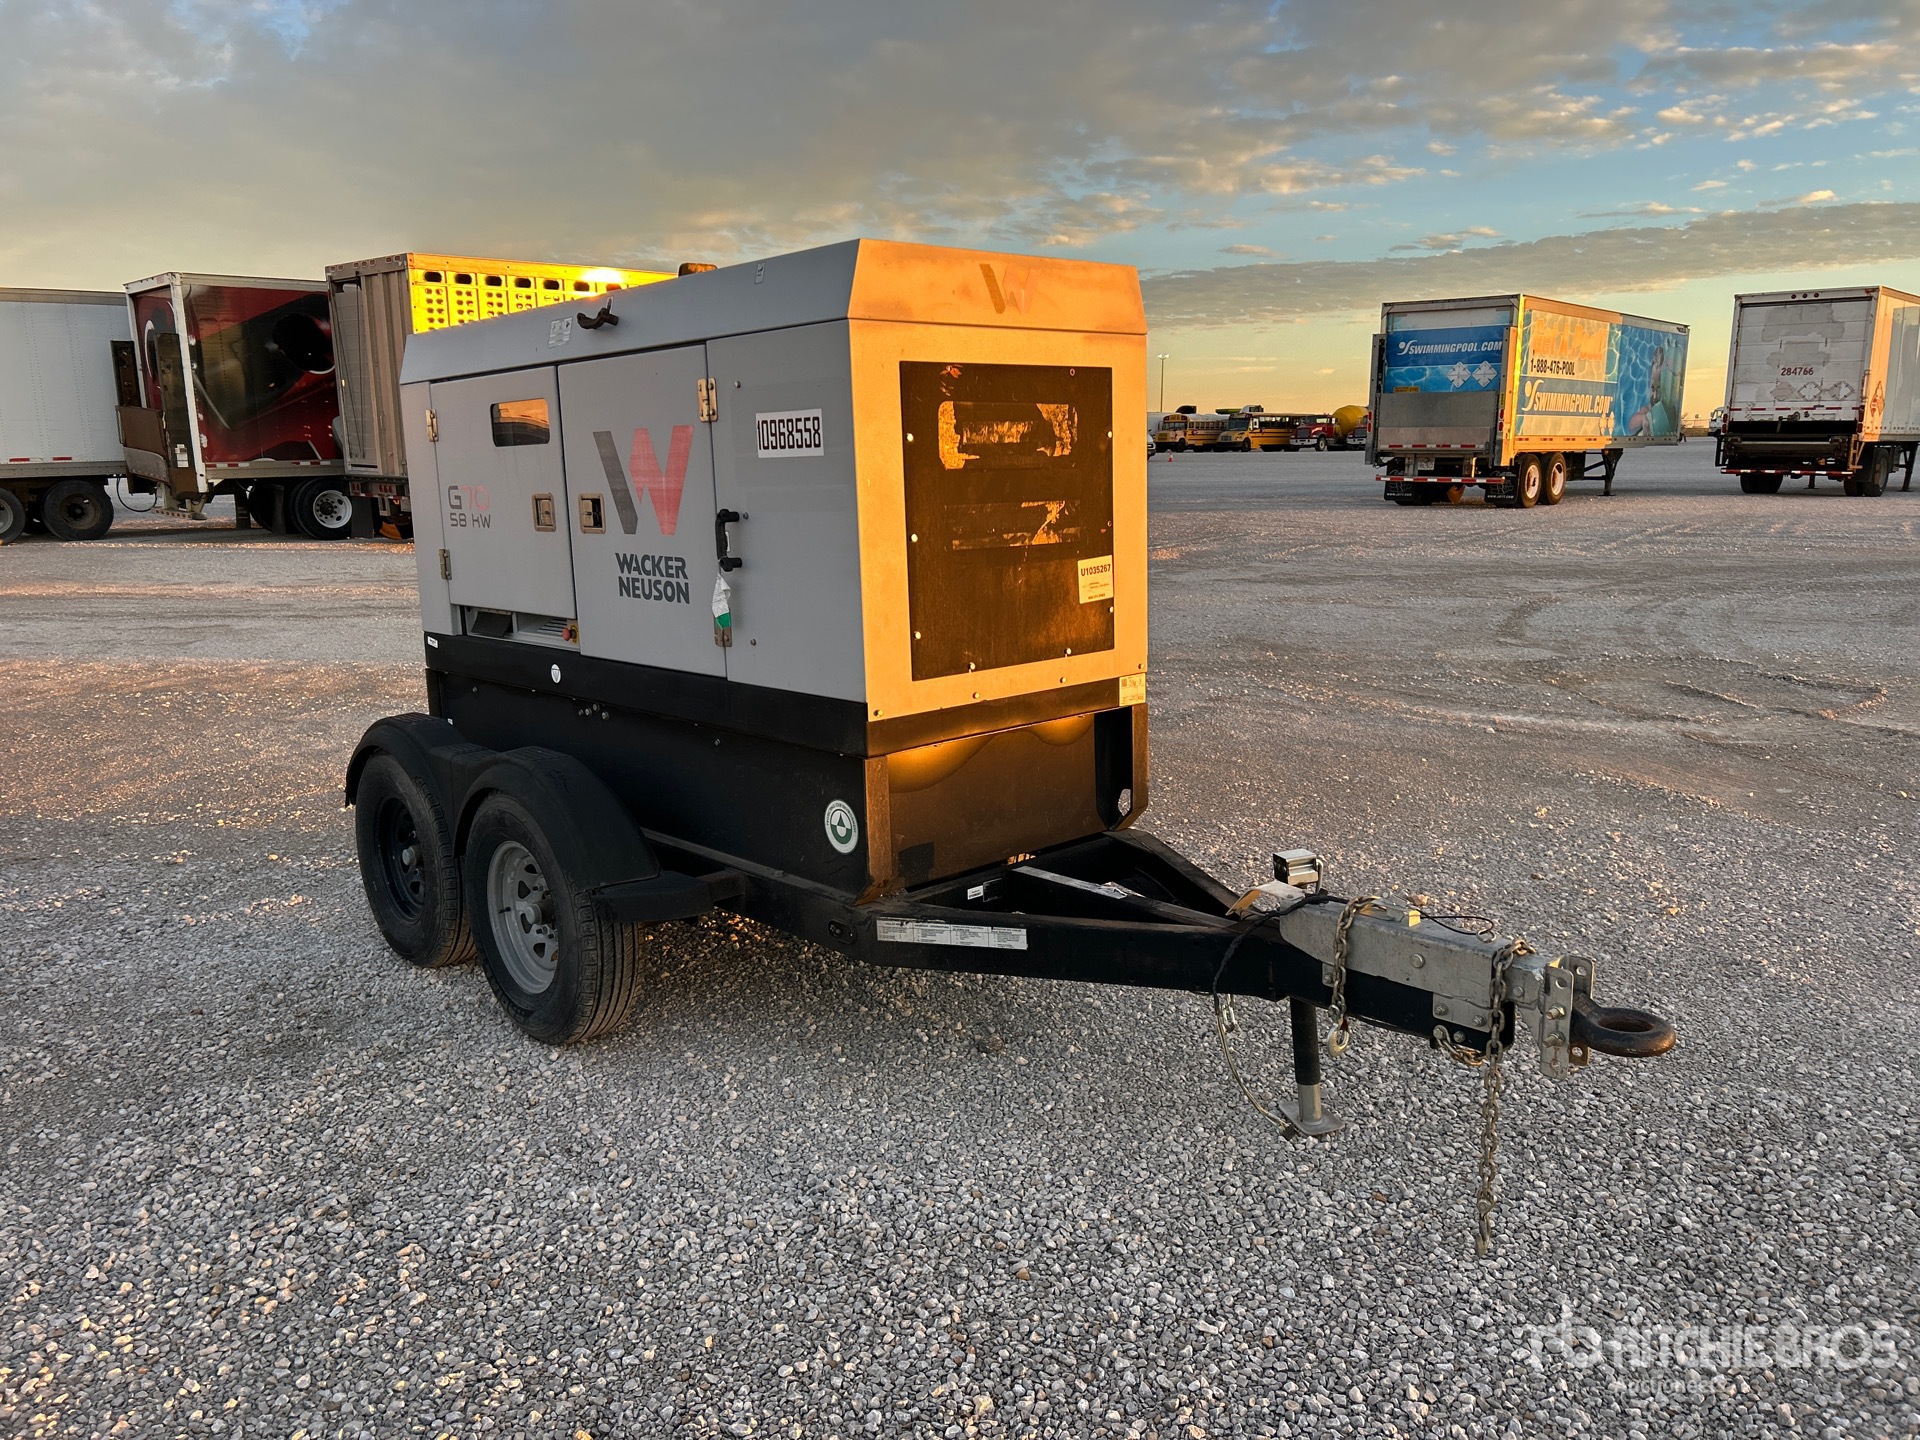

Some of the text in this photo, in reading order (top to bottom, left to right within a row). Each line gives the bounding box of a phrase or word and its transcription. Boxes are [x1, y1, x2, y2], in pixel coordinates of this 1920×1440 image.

[1408, 341, 1502, 355] SWIMMINGPOOL.COM
[1530, 357, 1575, 376] 1-888-476-POOL
[1780, 366, 1814, 377] 284766
[757, 416, 822, 450] 10968558
[592, 424, 695, 536] W
[447, 485, 490, 511] G70
[450, 512, 467, 527] 58
[615, 552, 688, 580] WACKER
[1080, 563, 1112, 577] U1035267
[618, 576, 690, 604] NEUSON
